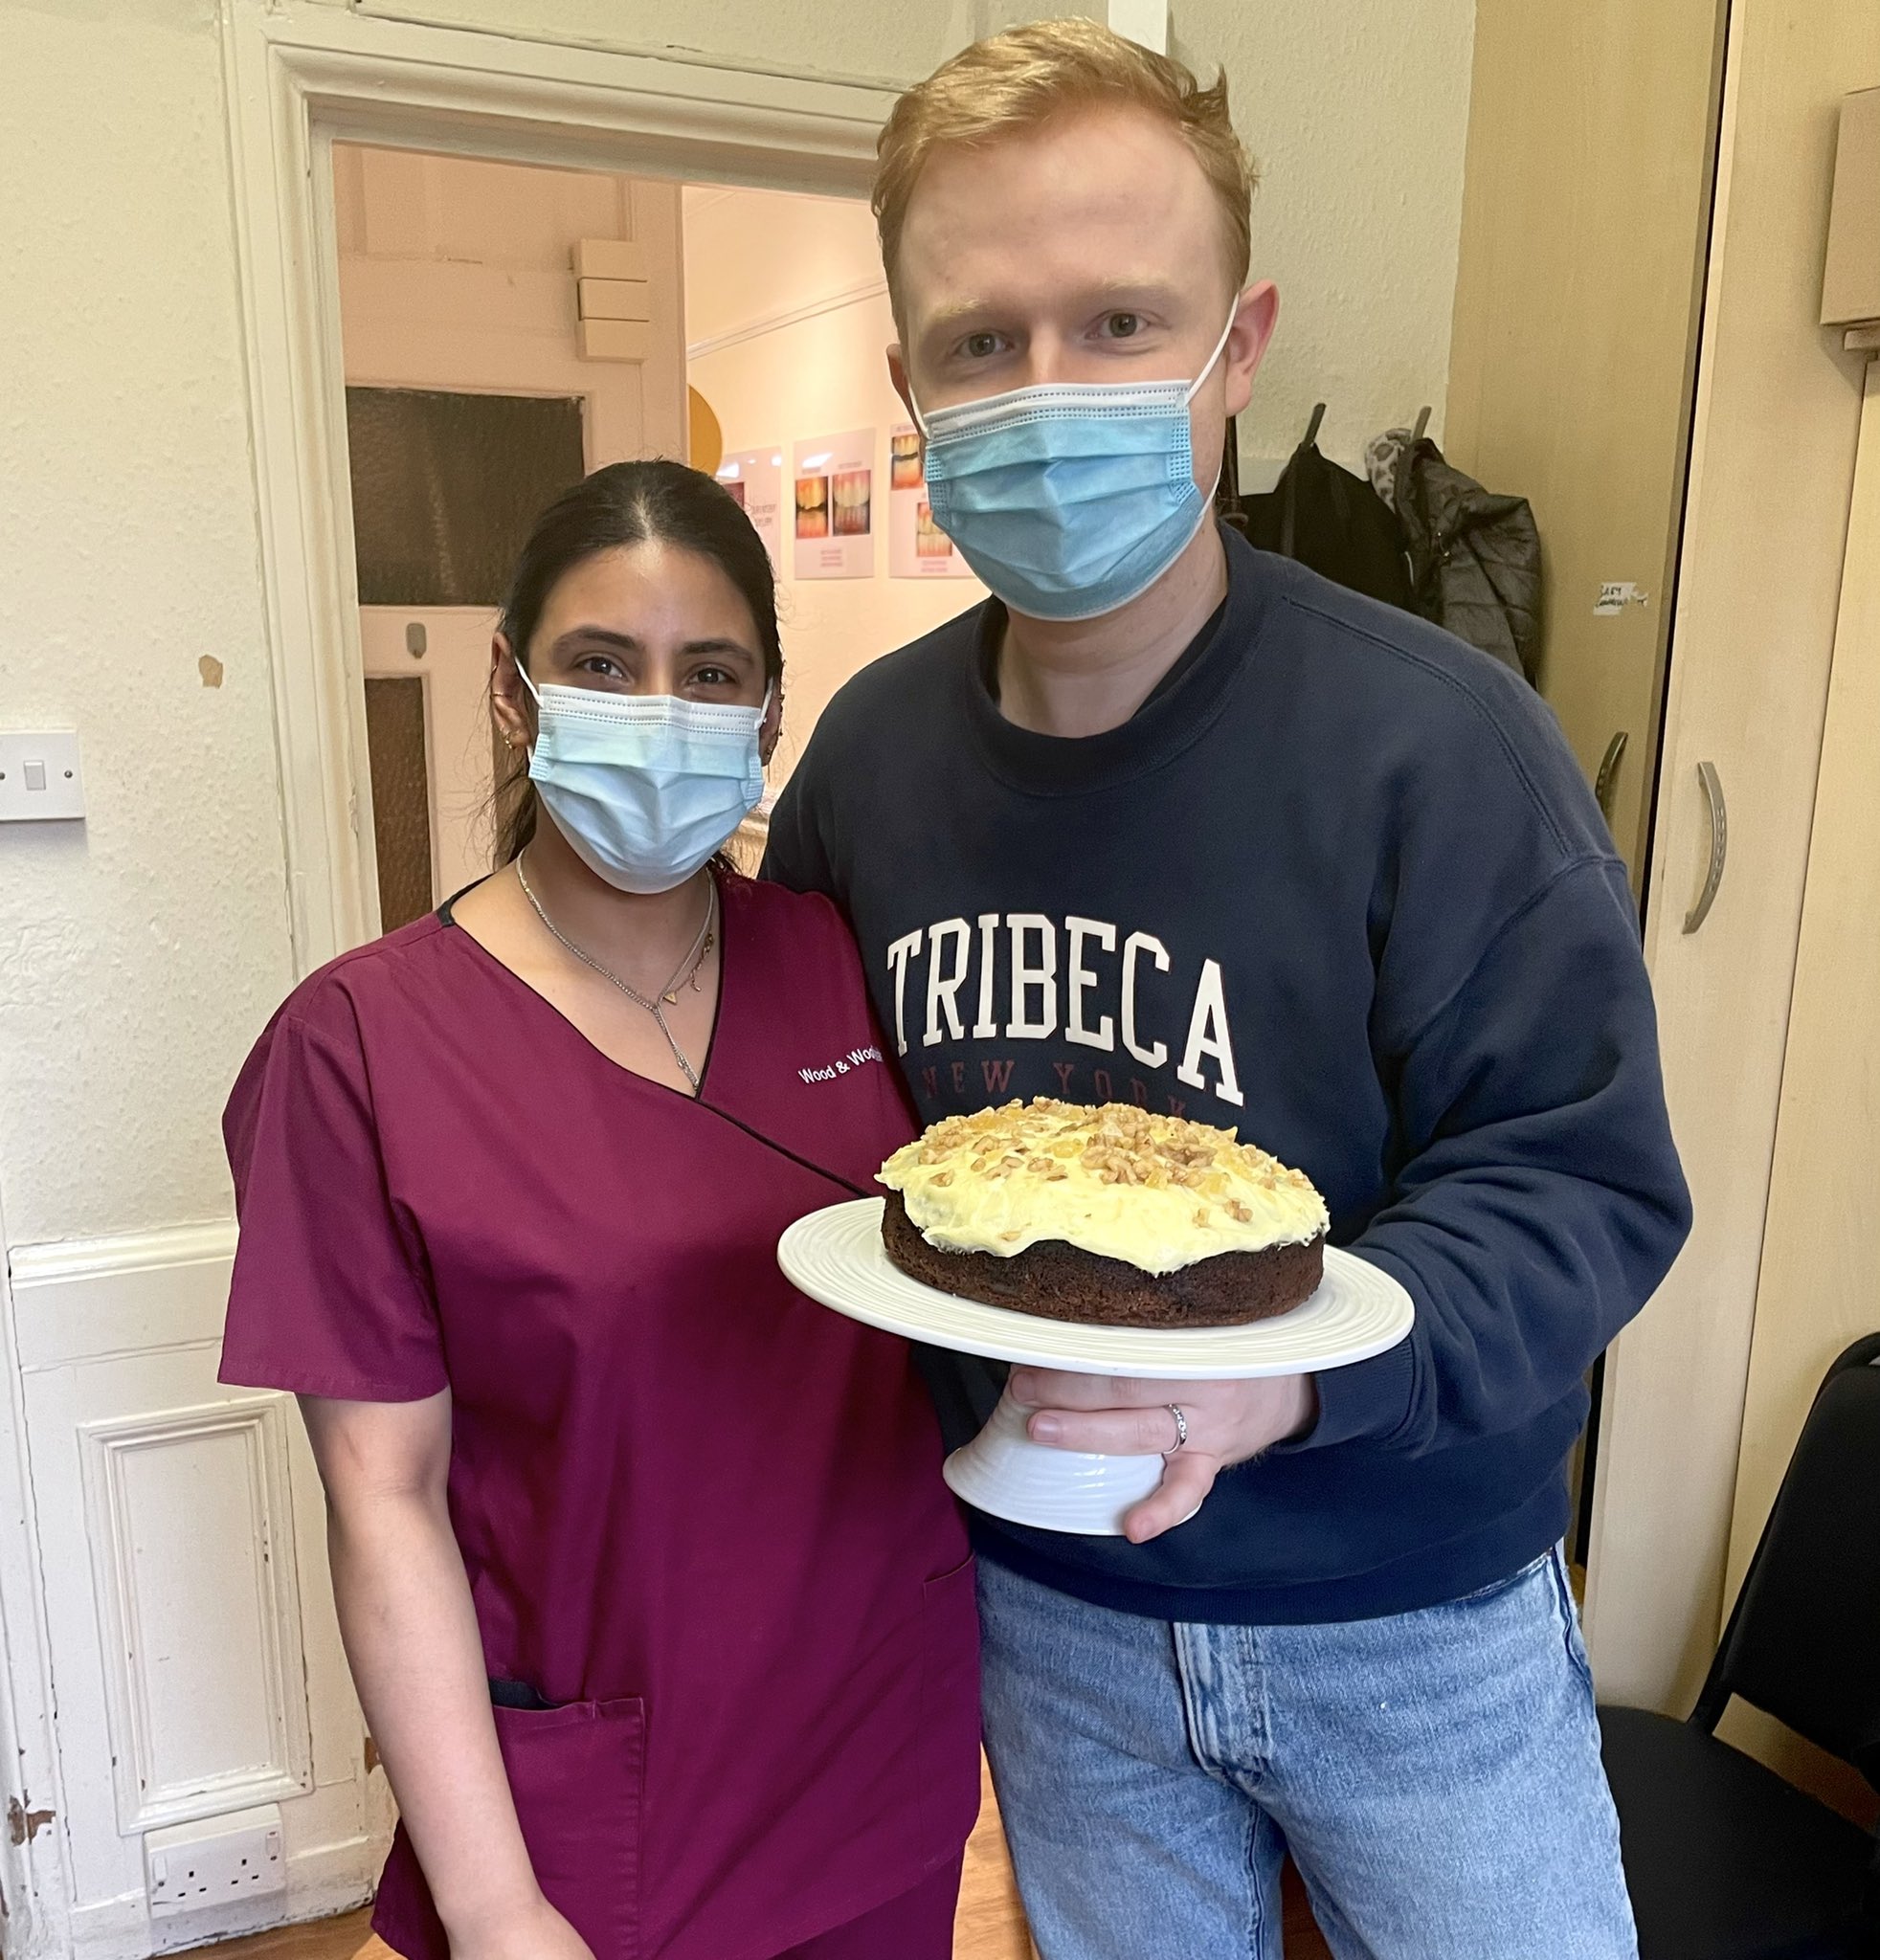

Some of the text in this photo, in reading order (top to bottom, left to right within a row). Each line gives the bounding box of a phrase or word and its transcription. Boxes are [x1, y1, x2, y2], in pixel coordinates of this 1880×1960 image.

[886, 913, 1244, 1107] TRIBECA
[797, 1064, 837, 1084] Wood
[835, 1060, 850, 1074] &
[922, 1059, 1016, 1099] NEW
